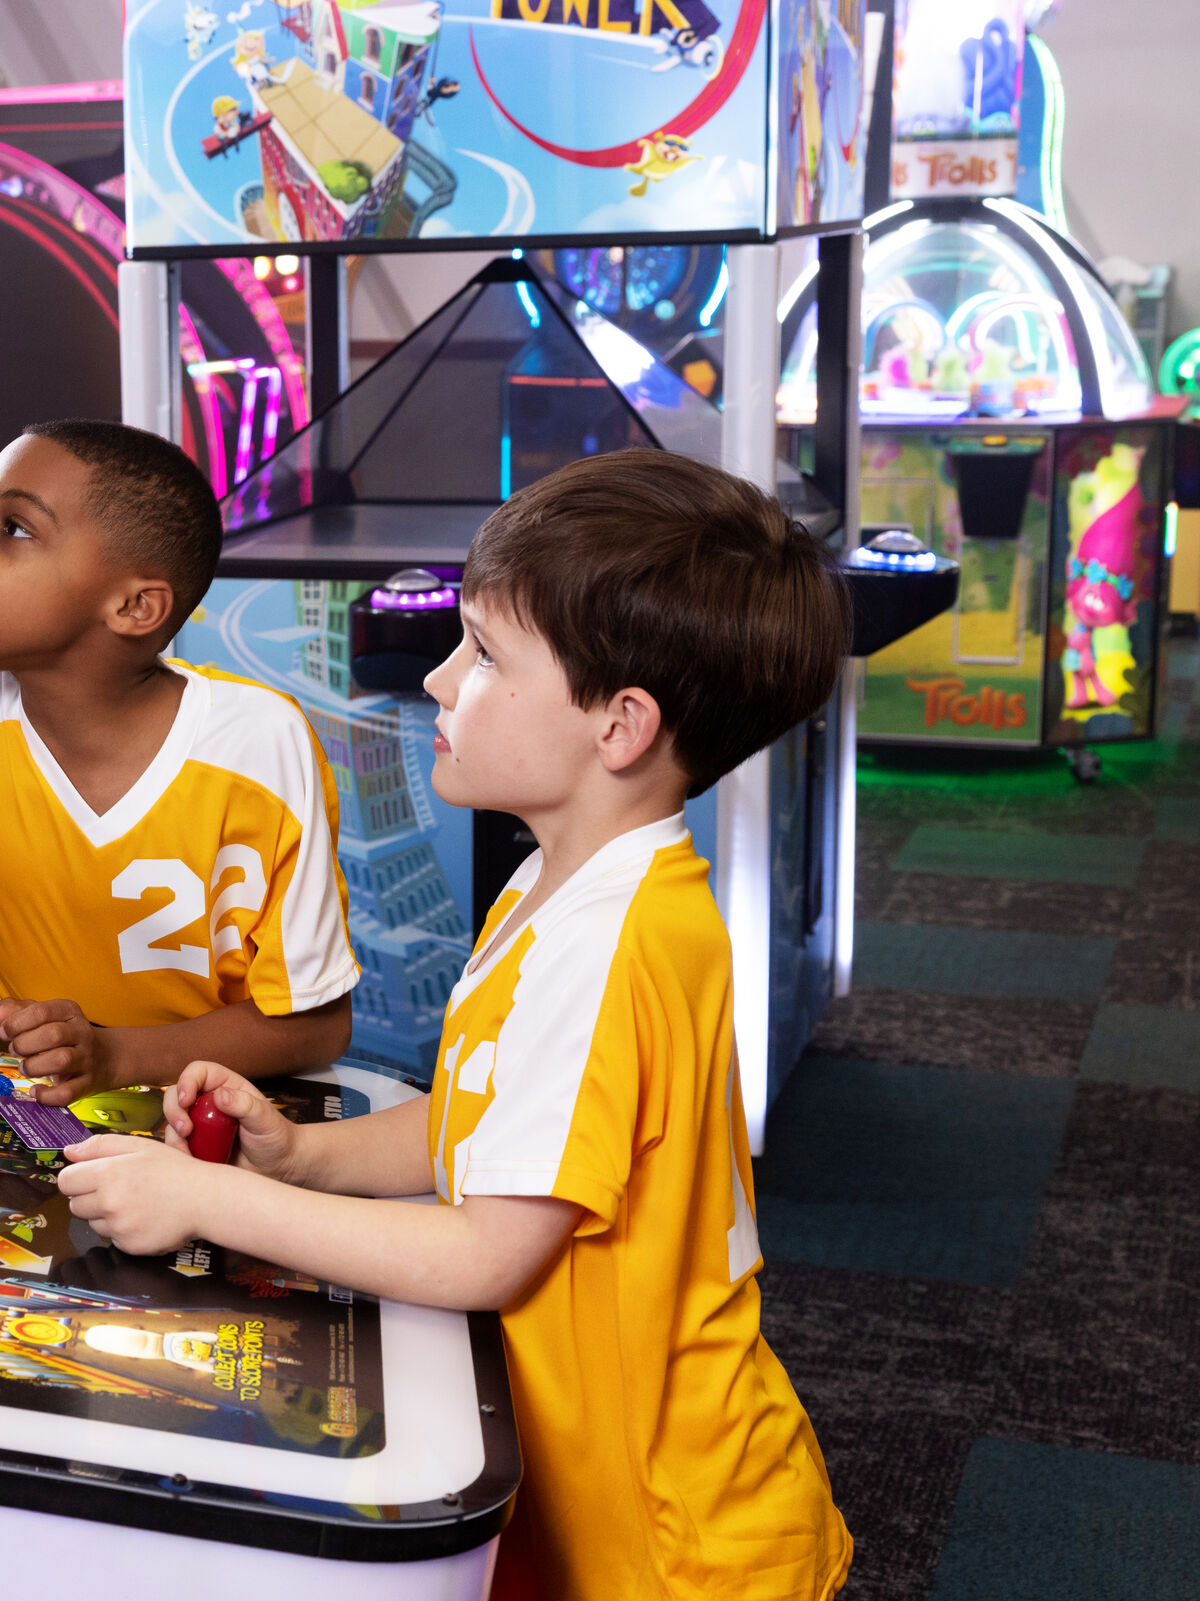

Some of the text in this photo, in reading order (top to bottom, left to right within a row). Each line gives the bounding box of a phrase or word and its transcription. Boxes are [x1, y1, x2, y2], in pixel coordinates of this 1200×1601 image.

[917, 152, 997, 188] Trolls
[906, 678, 1028, 731] Trolls
[324, 1095, 342, 1119] SYBO
[176, 1241, 194, 1266] MOVE
[193, 1247, 211, 1269] LEFT
[212, 1324, 239, 1391] COLLECT COINS
[240, 1320, 264, 1401] TO SCORE POINTS
